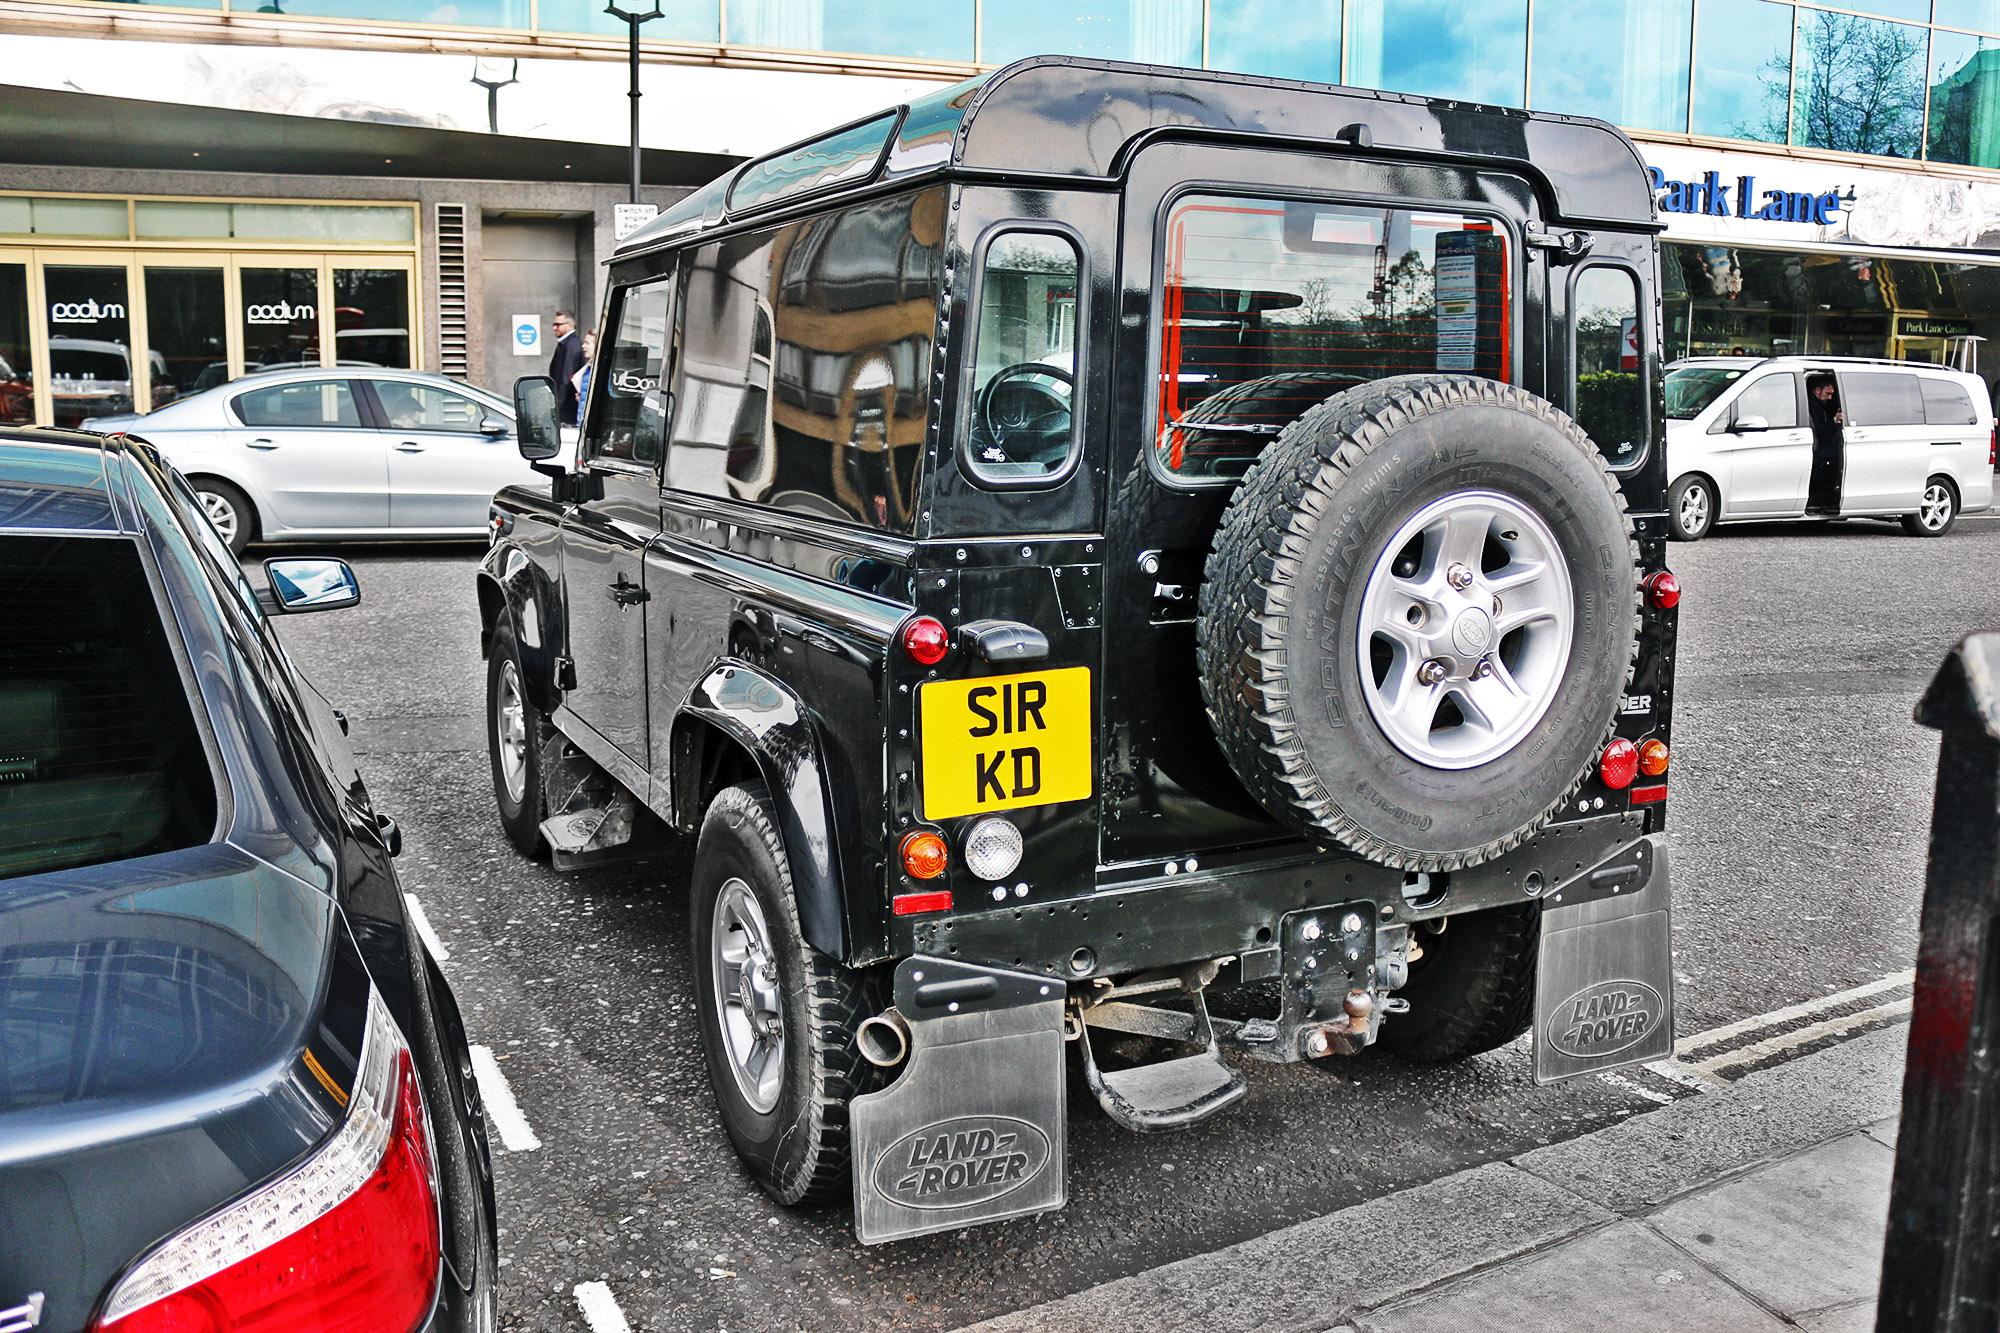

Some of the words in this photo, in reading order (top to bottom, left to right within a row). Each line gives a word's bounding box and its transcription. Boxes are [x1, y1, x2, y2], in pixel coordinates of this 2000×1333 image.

[1735, 176, 1840, 225] Lane
[52, 298, 125, 323] podium
[248, 299, 314, 323] podium
[1906, 321, 1924, 333] Park
[1925, 322, 1943, 334] Lane
[1320, 436, 1478, 728] CONTINENTAL
[976, 746, 1041, 803] KD
[1571, 990, 1628, 1024] LAND
[1574, 1010, 1650, 1048] ROVER
[907, 1127, 996, 1168] LAND
[916, 1152, 1029, 1196] ROVER
